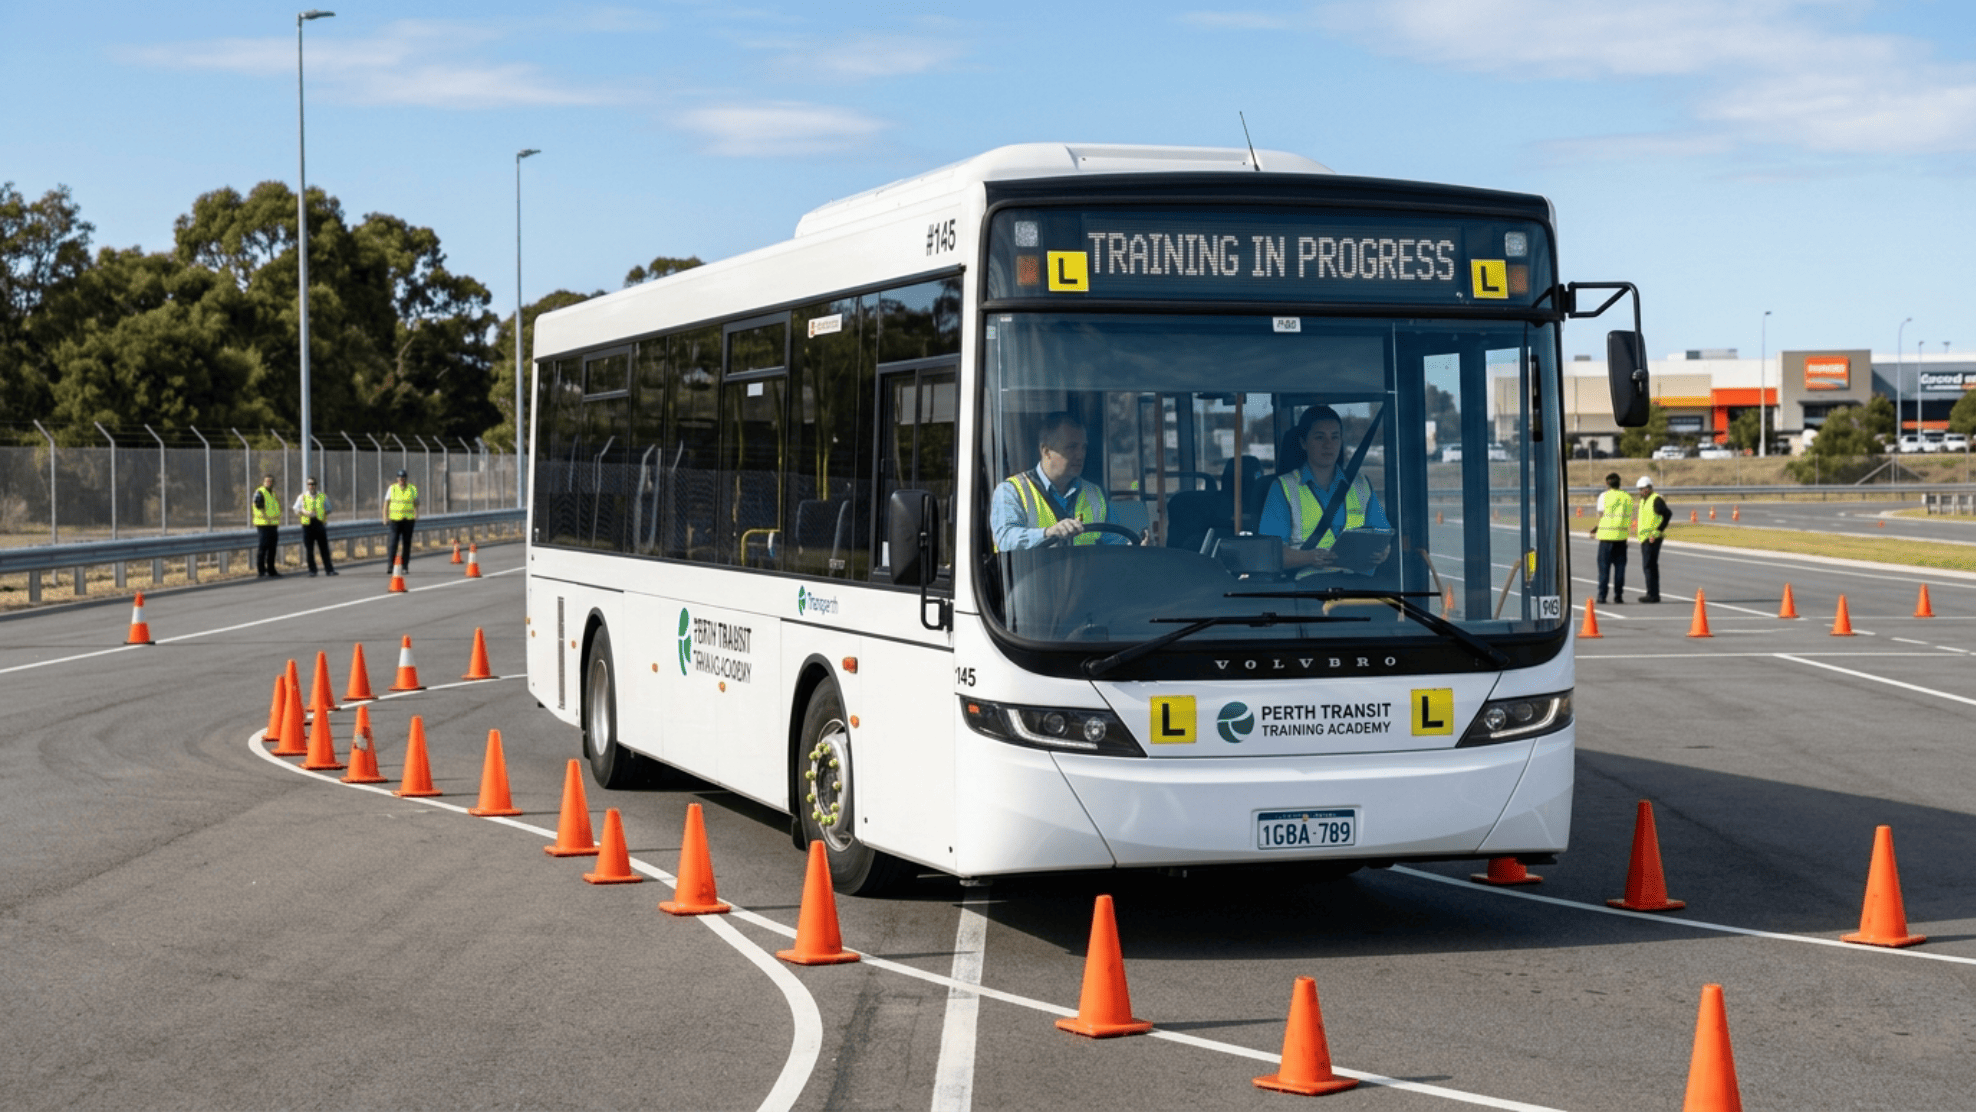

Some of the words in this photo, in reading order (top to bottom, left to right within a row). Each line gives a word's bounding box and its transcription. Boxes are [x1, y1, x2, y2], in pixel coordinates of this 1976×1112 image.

[926, 218, 957, 256] #145
[1087, 232, 1239, 276] TRAINING
[1252, 235, 1285, 277] IN
[1298, 236, 1455, 280] PROGRESS
[1057, 257, 1078, 285] L
[1480, 265, 1500, 292] L
[1215, 656, 1397, 670] VOLVBRO
[1161, 702, 1186, 736] L
[1261, 704, 1316, 721] PERTH
[1320, 703, 1391, 719] TRANSIT
[1421, 695, 1444, 729] L
[1262, 723, 1324, 737] TRAINING
[1327, 721, 1391, 736] ACADEMY
